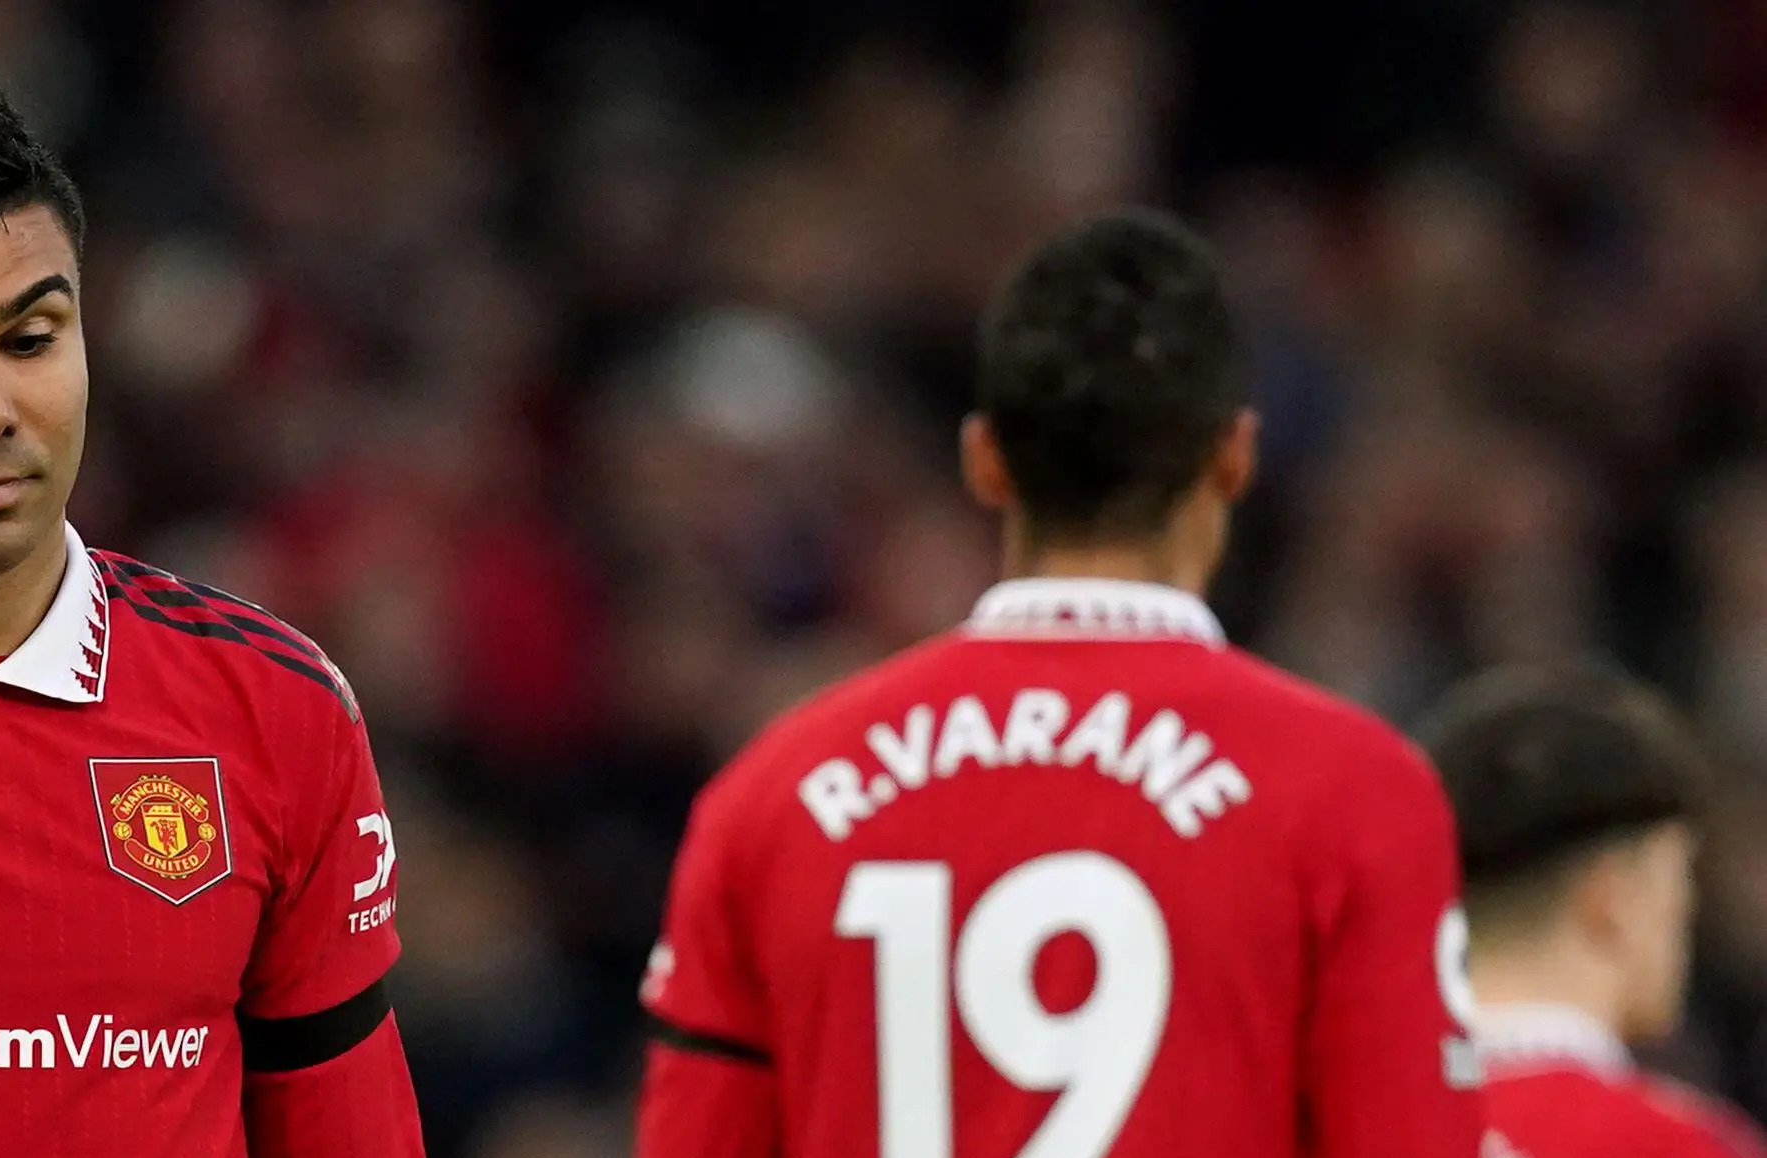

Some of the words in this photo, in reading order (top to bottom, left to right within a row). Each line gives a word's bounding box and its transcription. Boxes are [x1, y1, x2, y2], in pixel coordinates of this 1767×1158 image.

[799, 687, 1251, 841] R.VARANE
[119, 782, 202, 816] MANCHESTER
[143, 853, 199, 871] UNITED
